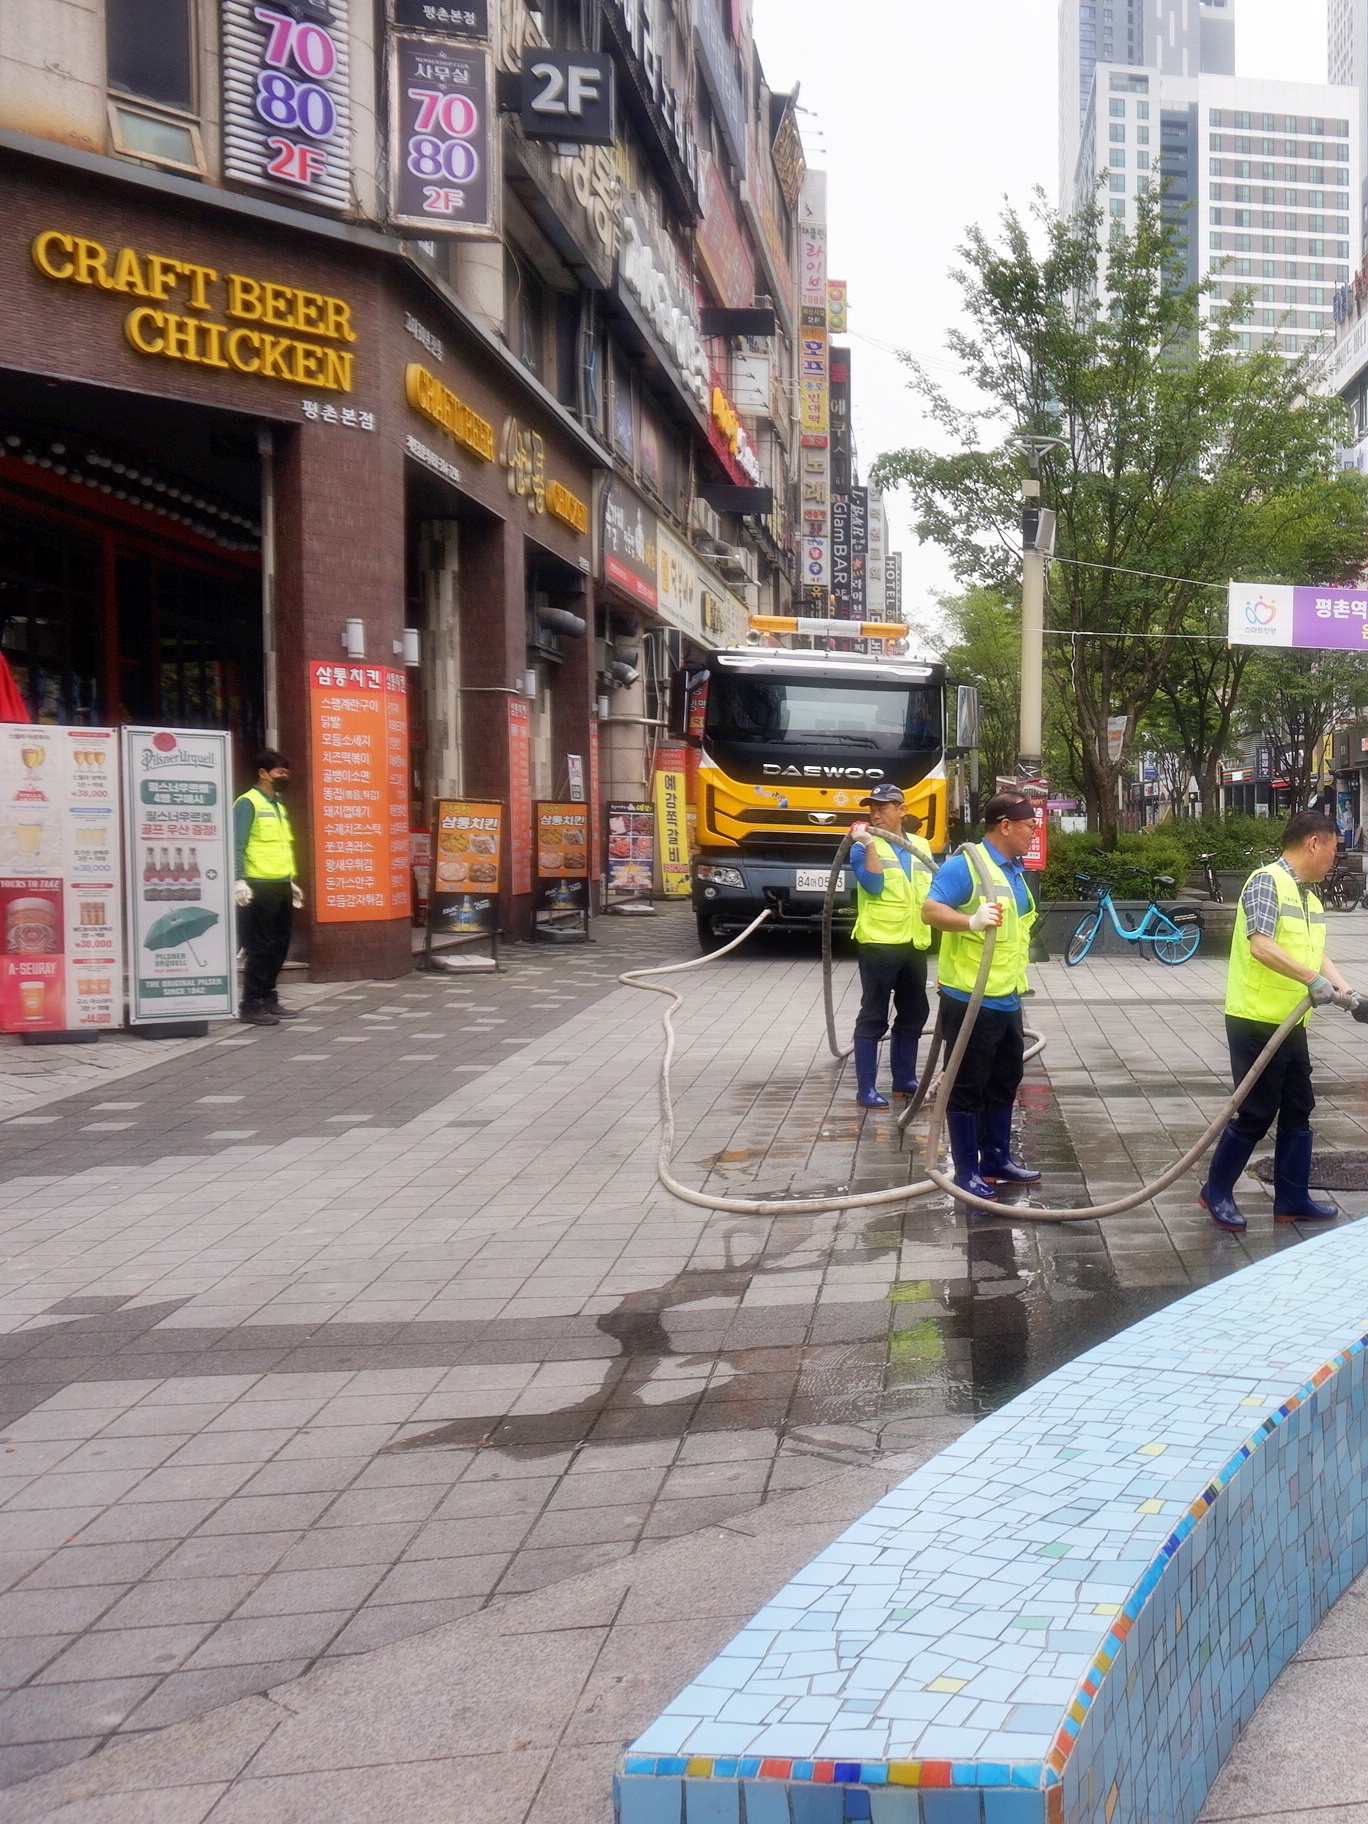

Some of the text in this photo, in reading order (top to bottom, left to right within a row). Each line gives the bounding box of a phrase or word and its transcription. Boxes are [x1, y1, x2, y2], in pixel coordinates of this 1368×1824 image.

[422, 5, 477, 26] 평촌본점
[254, 6, 337, 79] 70
[414, 63, 469, 84] 사무실
[530, 62, 601, 116] 2F
[256, 68, 337, 140] 80
[408, 88, 477, 138] 70
[266, 135, 328, 186] 2F
[407, 134, 478, 183] 80
[422, 185, 464, 212] 2F
[805, 242, 824, 291] 라이브
[31, 228, 217, 311] CRAFT
[225, 272, 356, 343] BEER
[124, 306, 354, 393] CHICKEN
[803, 340, 824, 375] 호프
[302, 400, 374, 431] 평촌본점
[808, 393, 821, 424] 빈대떡
[833, 502, 847, 584] Glam BAR
[1244, 626, 1277, 637] 스마트안양
[316, 666, 380, 688] 삼통치킨
[321, 697, 378, 712] 스팸계란구이
[321, 715, 341, 729] 닭발
[141, 748, 214, 771] Pilsner Urquell
[322, 751, 369, 764] 치즈떡볶이
[322, 769, 370, 783] 골뱅이소면
[762, 763, 884, 779] DAEWOO
[323, 805, 370, 818] 돼지껍데기
[540, 815, 585, 826] 삼통치킨
[141, 824, 217, 836] 골프 우산 증정!
[324, 824, 382, 835] 수제치즈스틱
[441, 816, 499, 831] 삼통치킨
[325, 859, 373, 872] 왕새우튀김
[145, 980, 160, 988] THE
[161, 979, 195, 987] ORIGINAL
[163, 988, 185, 996] SINCE
